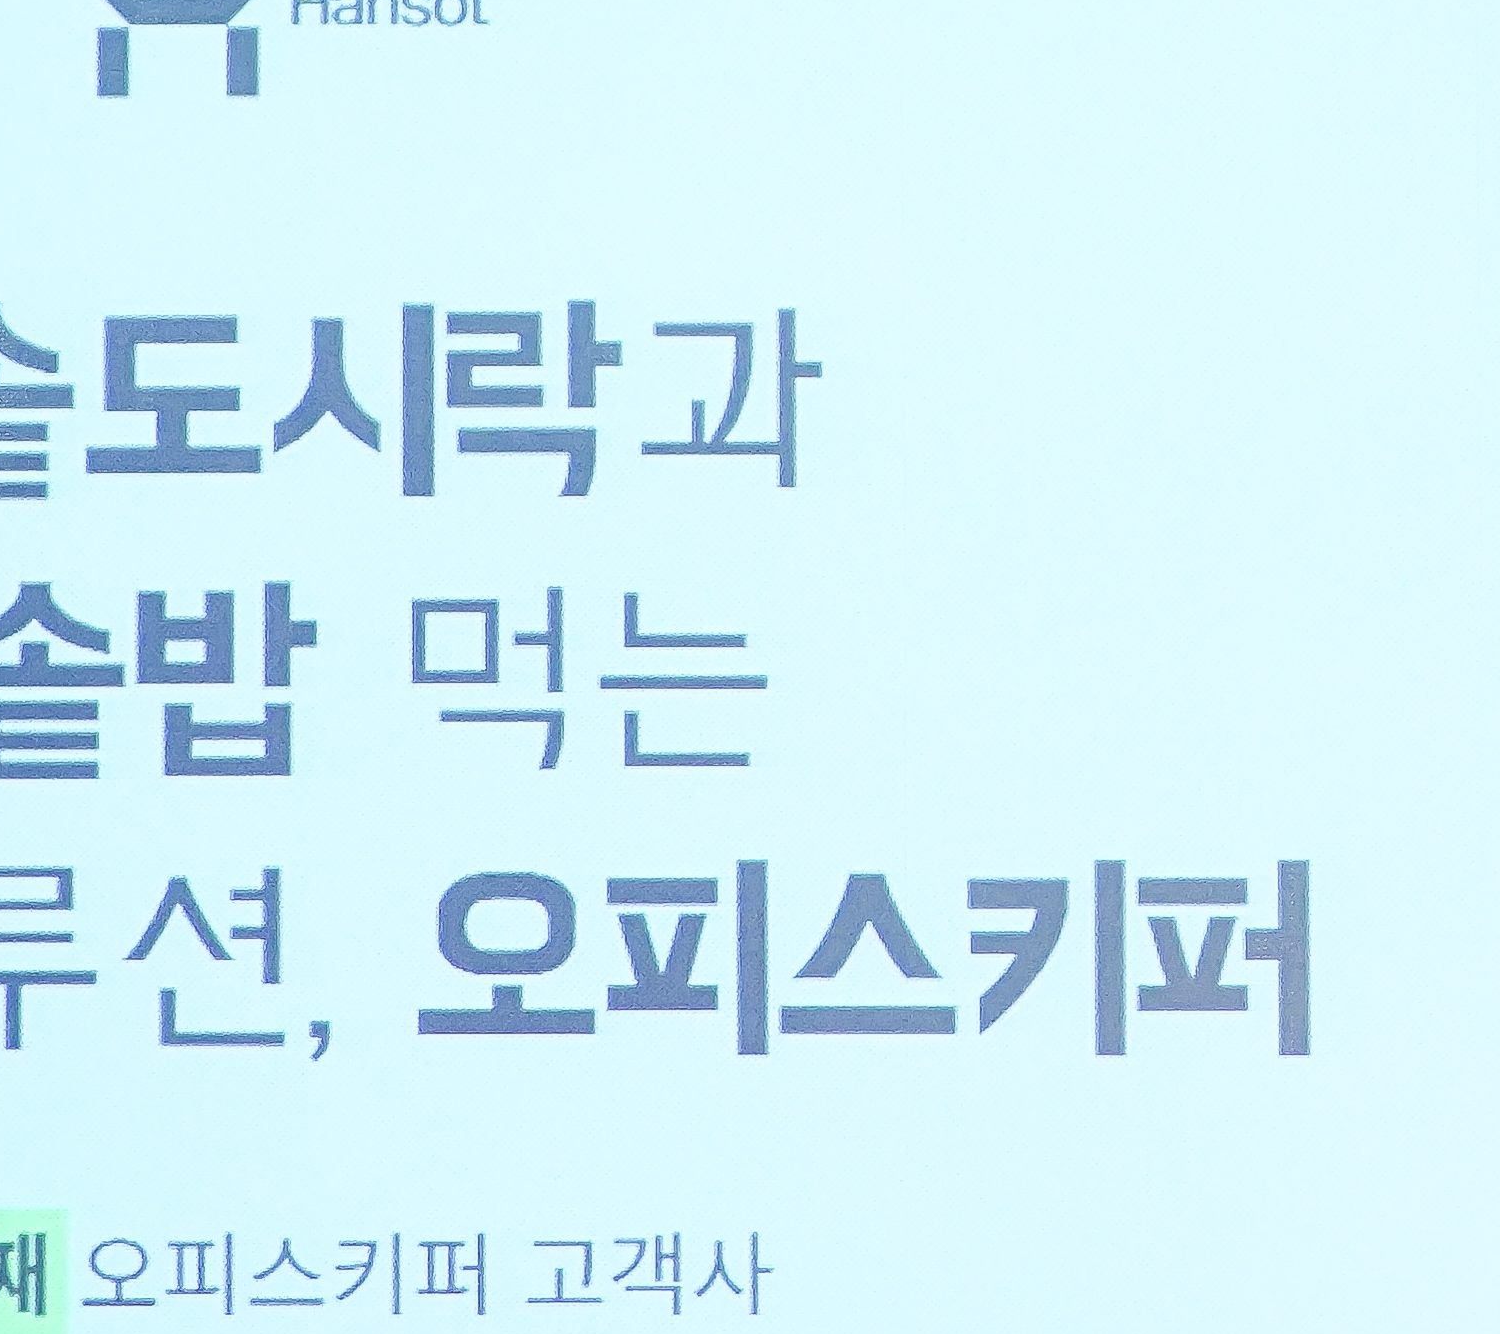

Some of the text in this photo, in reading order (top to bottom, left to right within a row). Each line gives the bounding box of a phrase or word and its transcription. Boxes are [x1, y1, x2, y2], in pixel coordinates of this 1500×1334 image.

[412, 586, 768, 769] 먹는
[418, 859, 1310, 1056] 오피스키퍼
[82, 1232, 485, 1315] 오피스키퍼
[527, 1232, 773, 1315] 고객사
